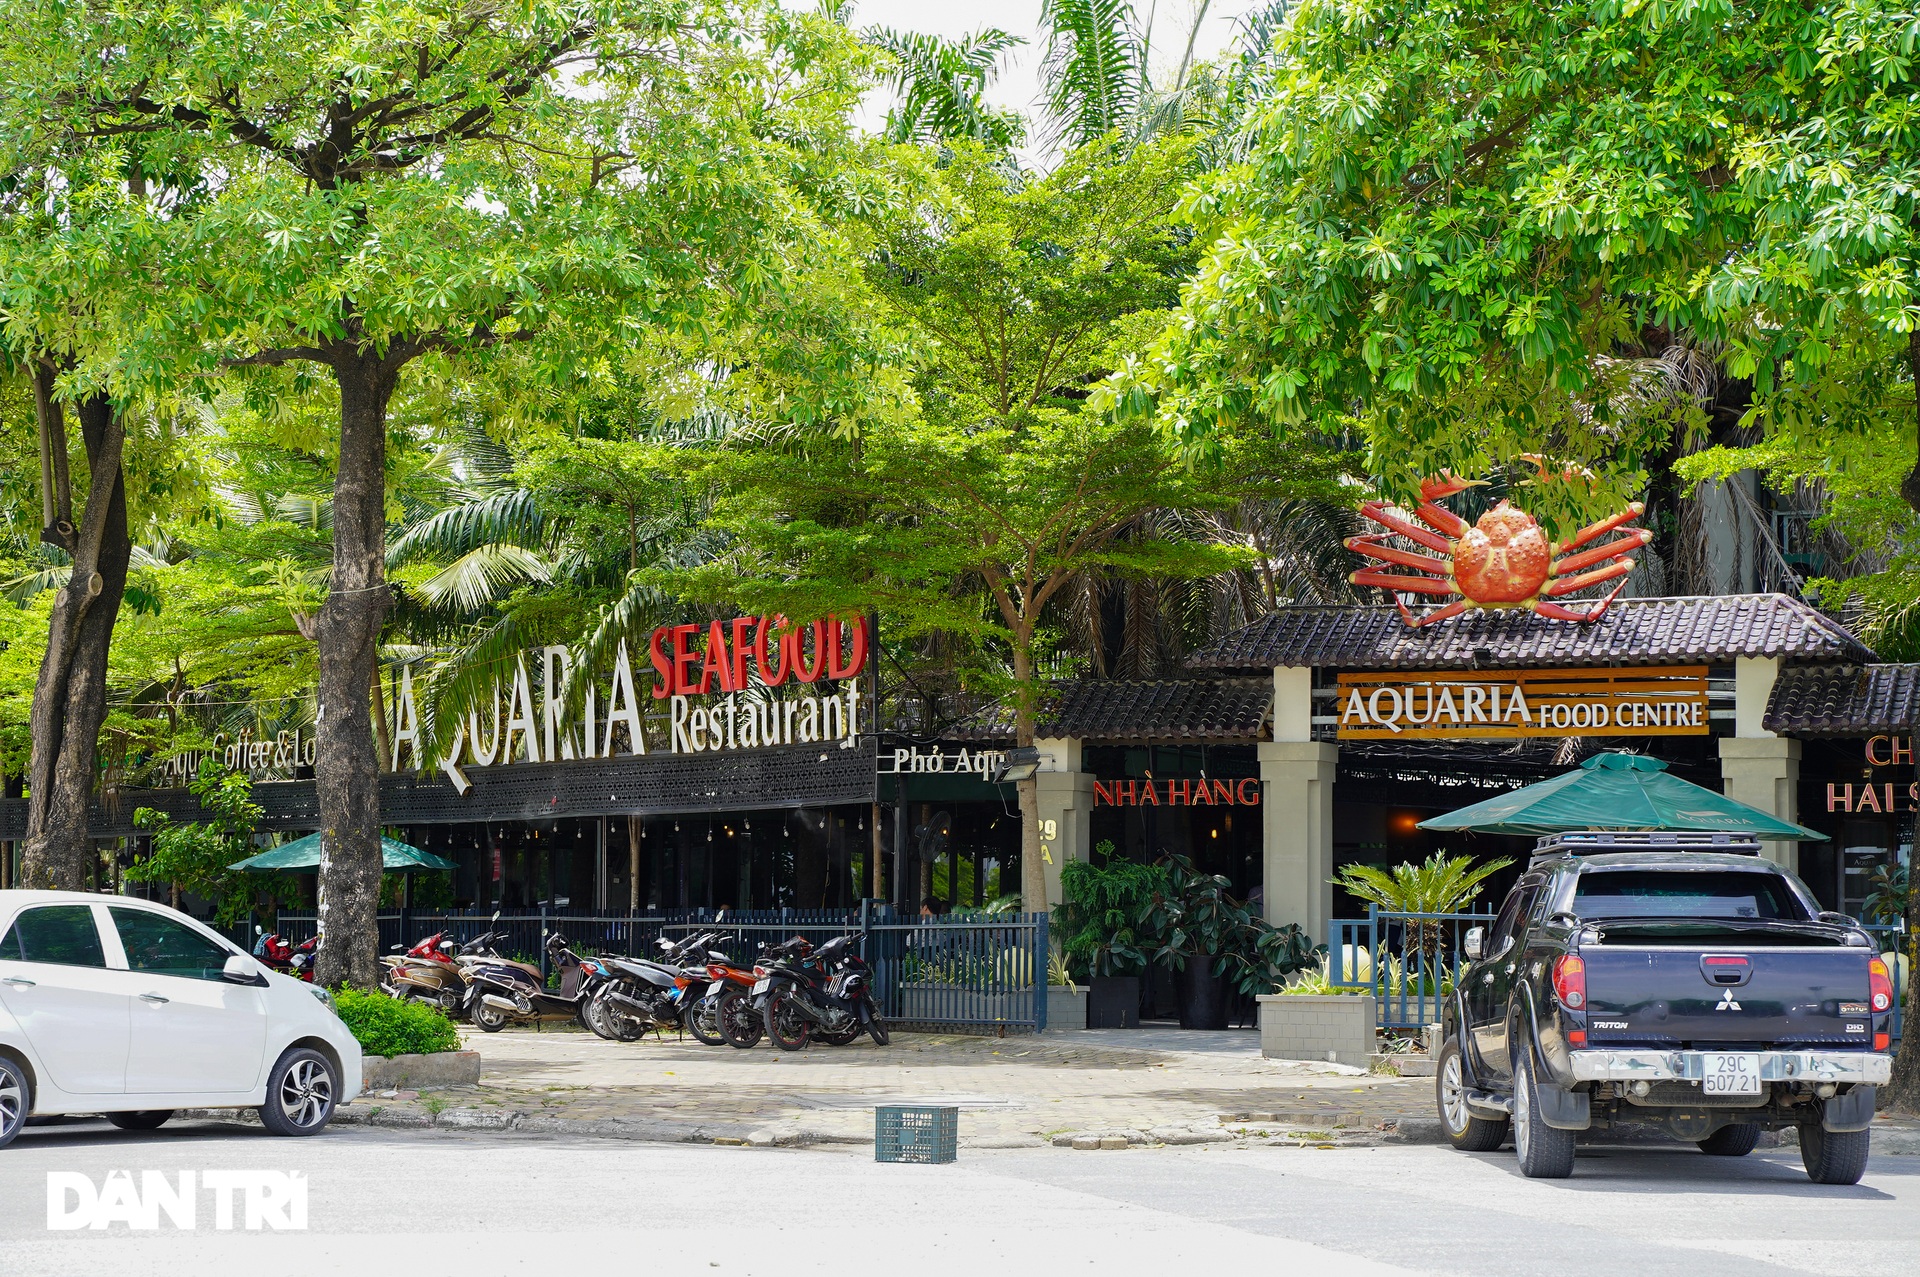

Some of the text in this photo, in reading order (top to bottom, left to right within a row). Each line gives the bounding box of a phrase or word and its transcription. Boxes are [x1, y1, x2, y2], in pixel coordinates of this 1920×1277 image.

[650, 611, 869, 699] SEAFOOD
[671, 677, 861, 754] Restaurant
[1342, 685, 1703, 733] AQUARIA FOOD CENTRE
[211, 727, 270, 771] Coffee
[274, 730, 292, 768] &
[893, 745, 944, 773] Phở
[1093, 769, 1259, 806] NHÀ HÀNG
[1827, 767, 1894, 813] HẢI
[1593, 1021, 1629, 1029] TRITON
[1706, 1074, 1757, 1091] 507.21
[1717, 1056, 1747, 1072] 29C
